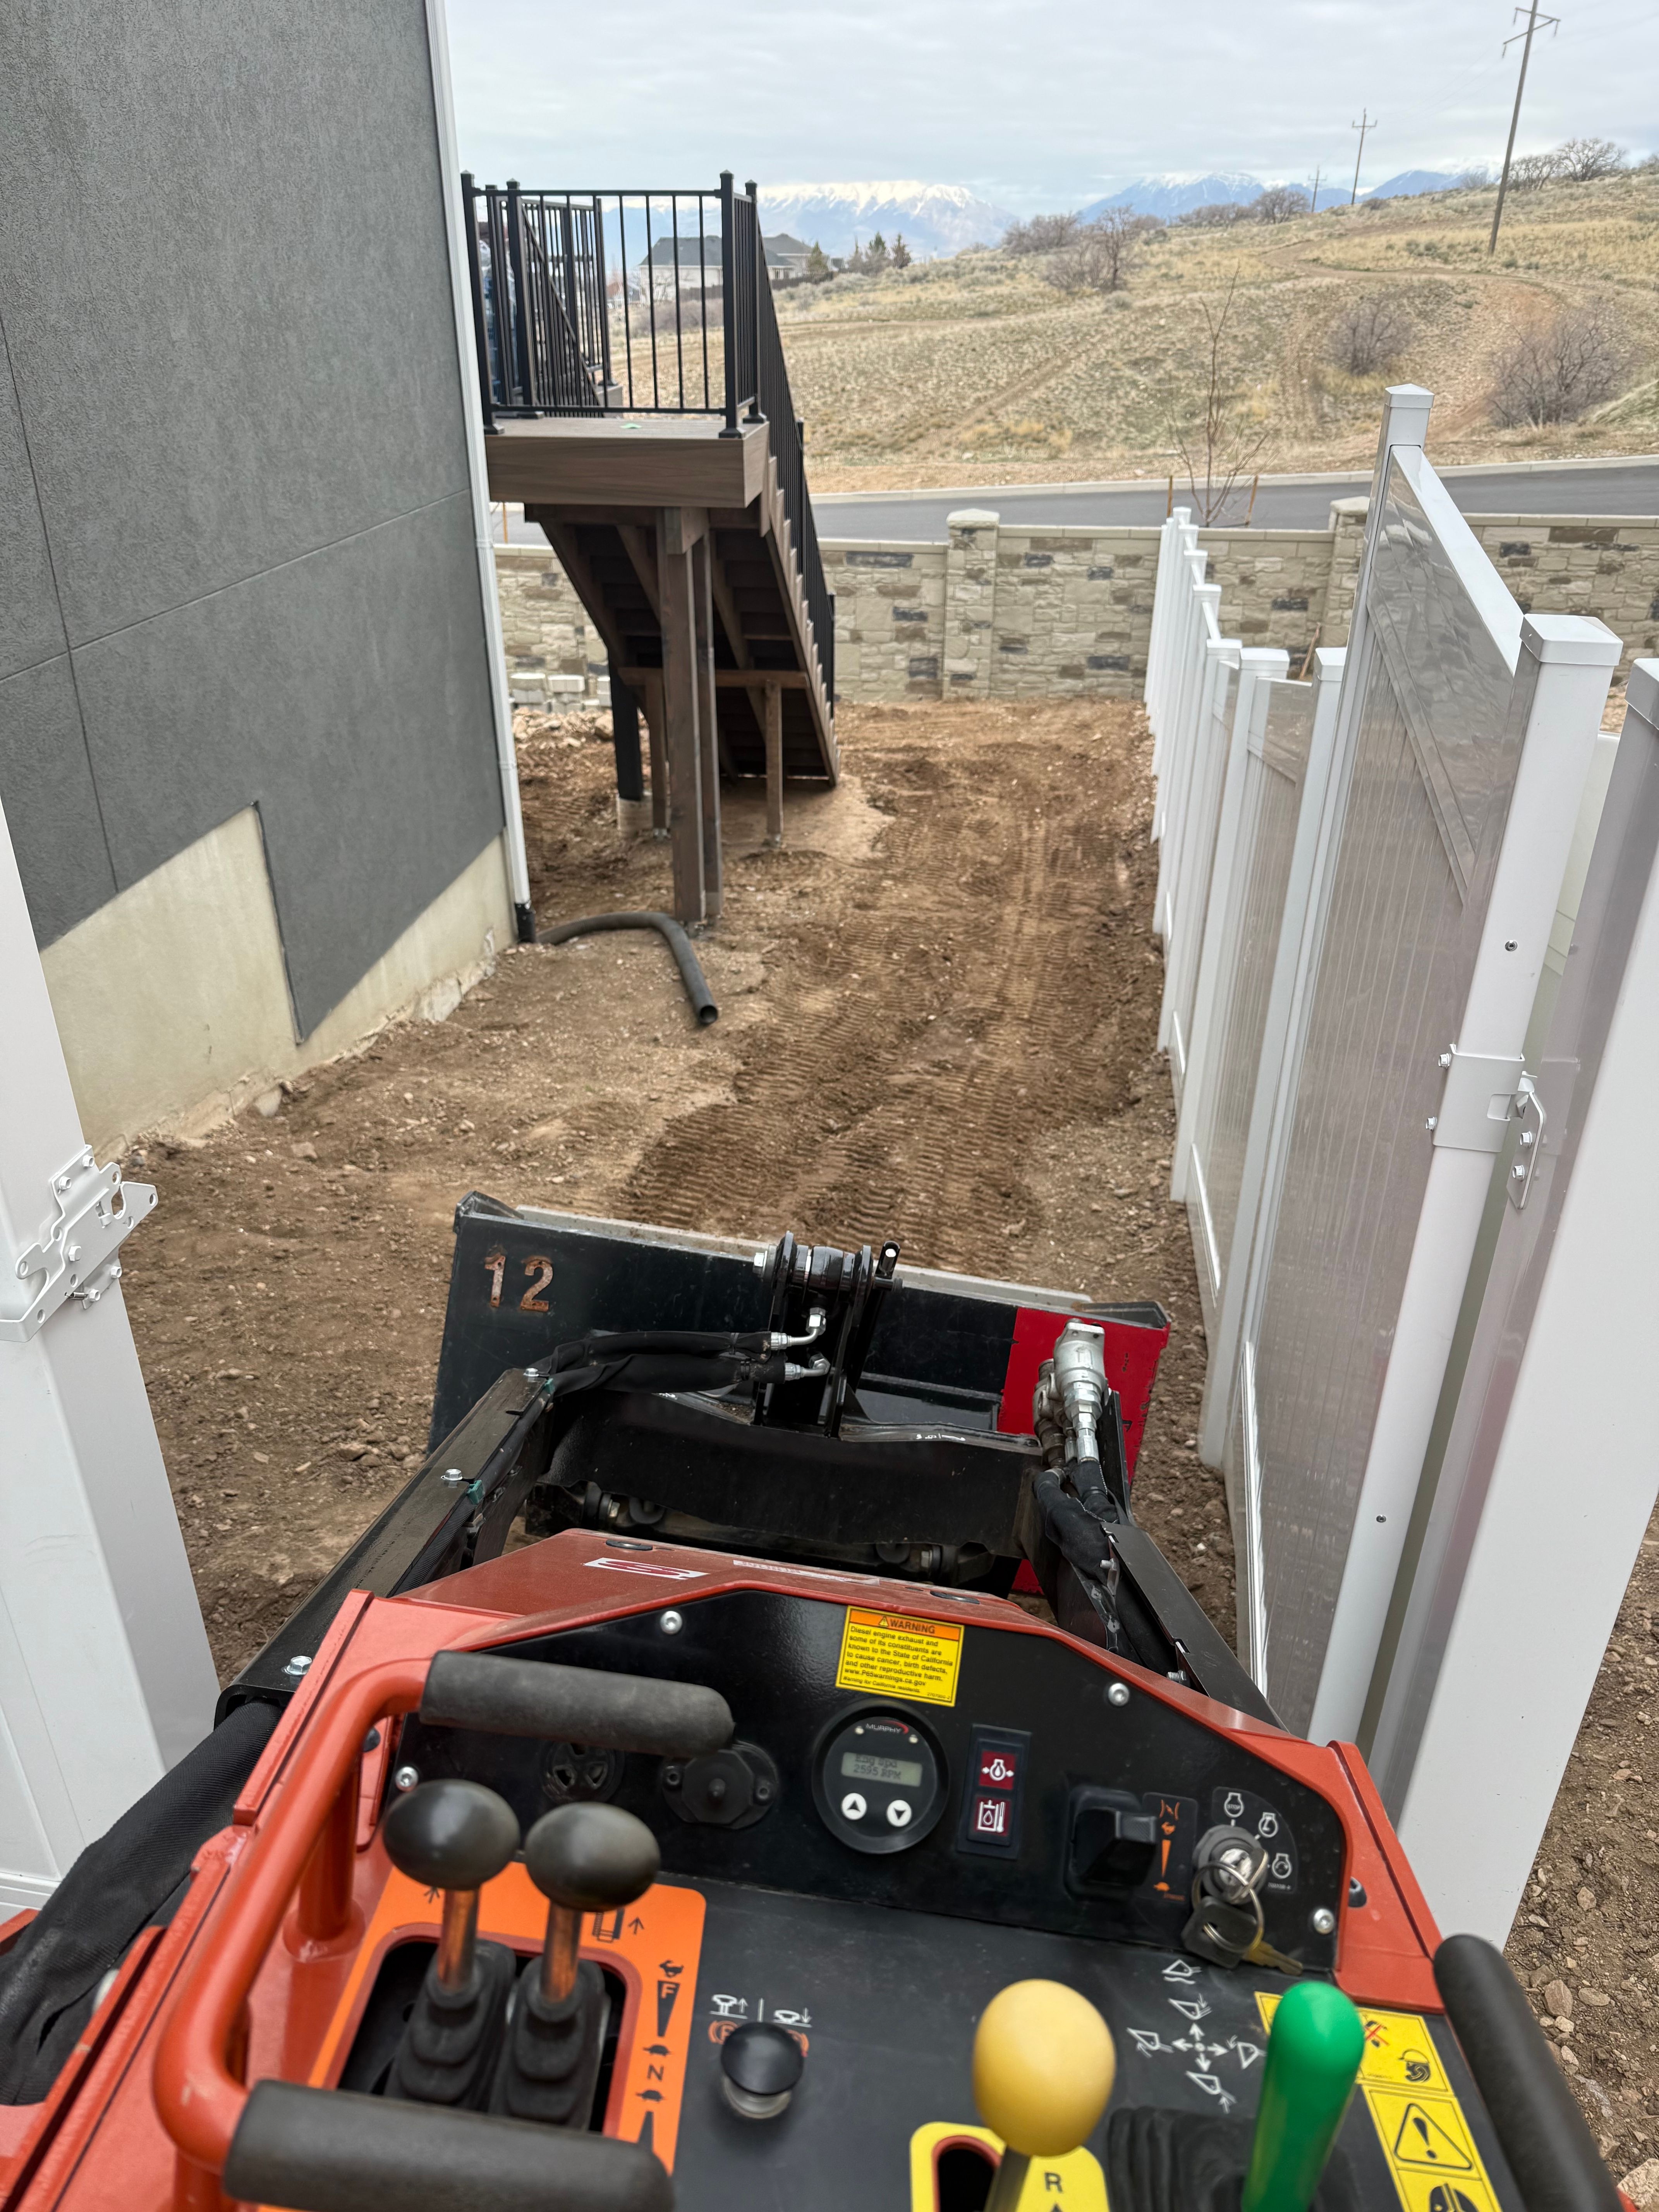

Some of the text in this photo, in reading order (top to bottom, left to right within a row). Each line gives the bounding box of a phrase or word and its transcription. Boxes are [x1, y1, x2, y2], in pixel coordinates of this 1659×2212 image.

[484, 1255, 553, 1312] 12
[890, 1618, 935, 1634] WARNING
[850, 1626, 871, 1635] Diesel
[873, 1630, 896, 1640] engine
[897, 1635, 924, 1644] exhaust
[848, 1643, 870, 1652] known
[893, 1650, 910, 1659] State
[921, 1655, 953, 1666] California
[888, 1641, 929, 1653] constituents
[860, 1662, 877, 1670] other
[879, 1665, 922, 1679] reproductive
[924, 1673, 943, 1681] harm.
[876, 1657, 902, 1666] cancer,
[904, 1661, 919, 1669] birth
[921, 1664, 948, 1674] defects,
[844, 1667, 926, 1687] www.P65warnings.ca.gov
[866, 1723, 902, 1733] MURPHY
[661, 1985, 677, 1998] F
[647, 2065, 665, 2081] N
[1044, 2172, 1063, 2193] R
